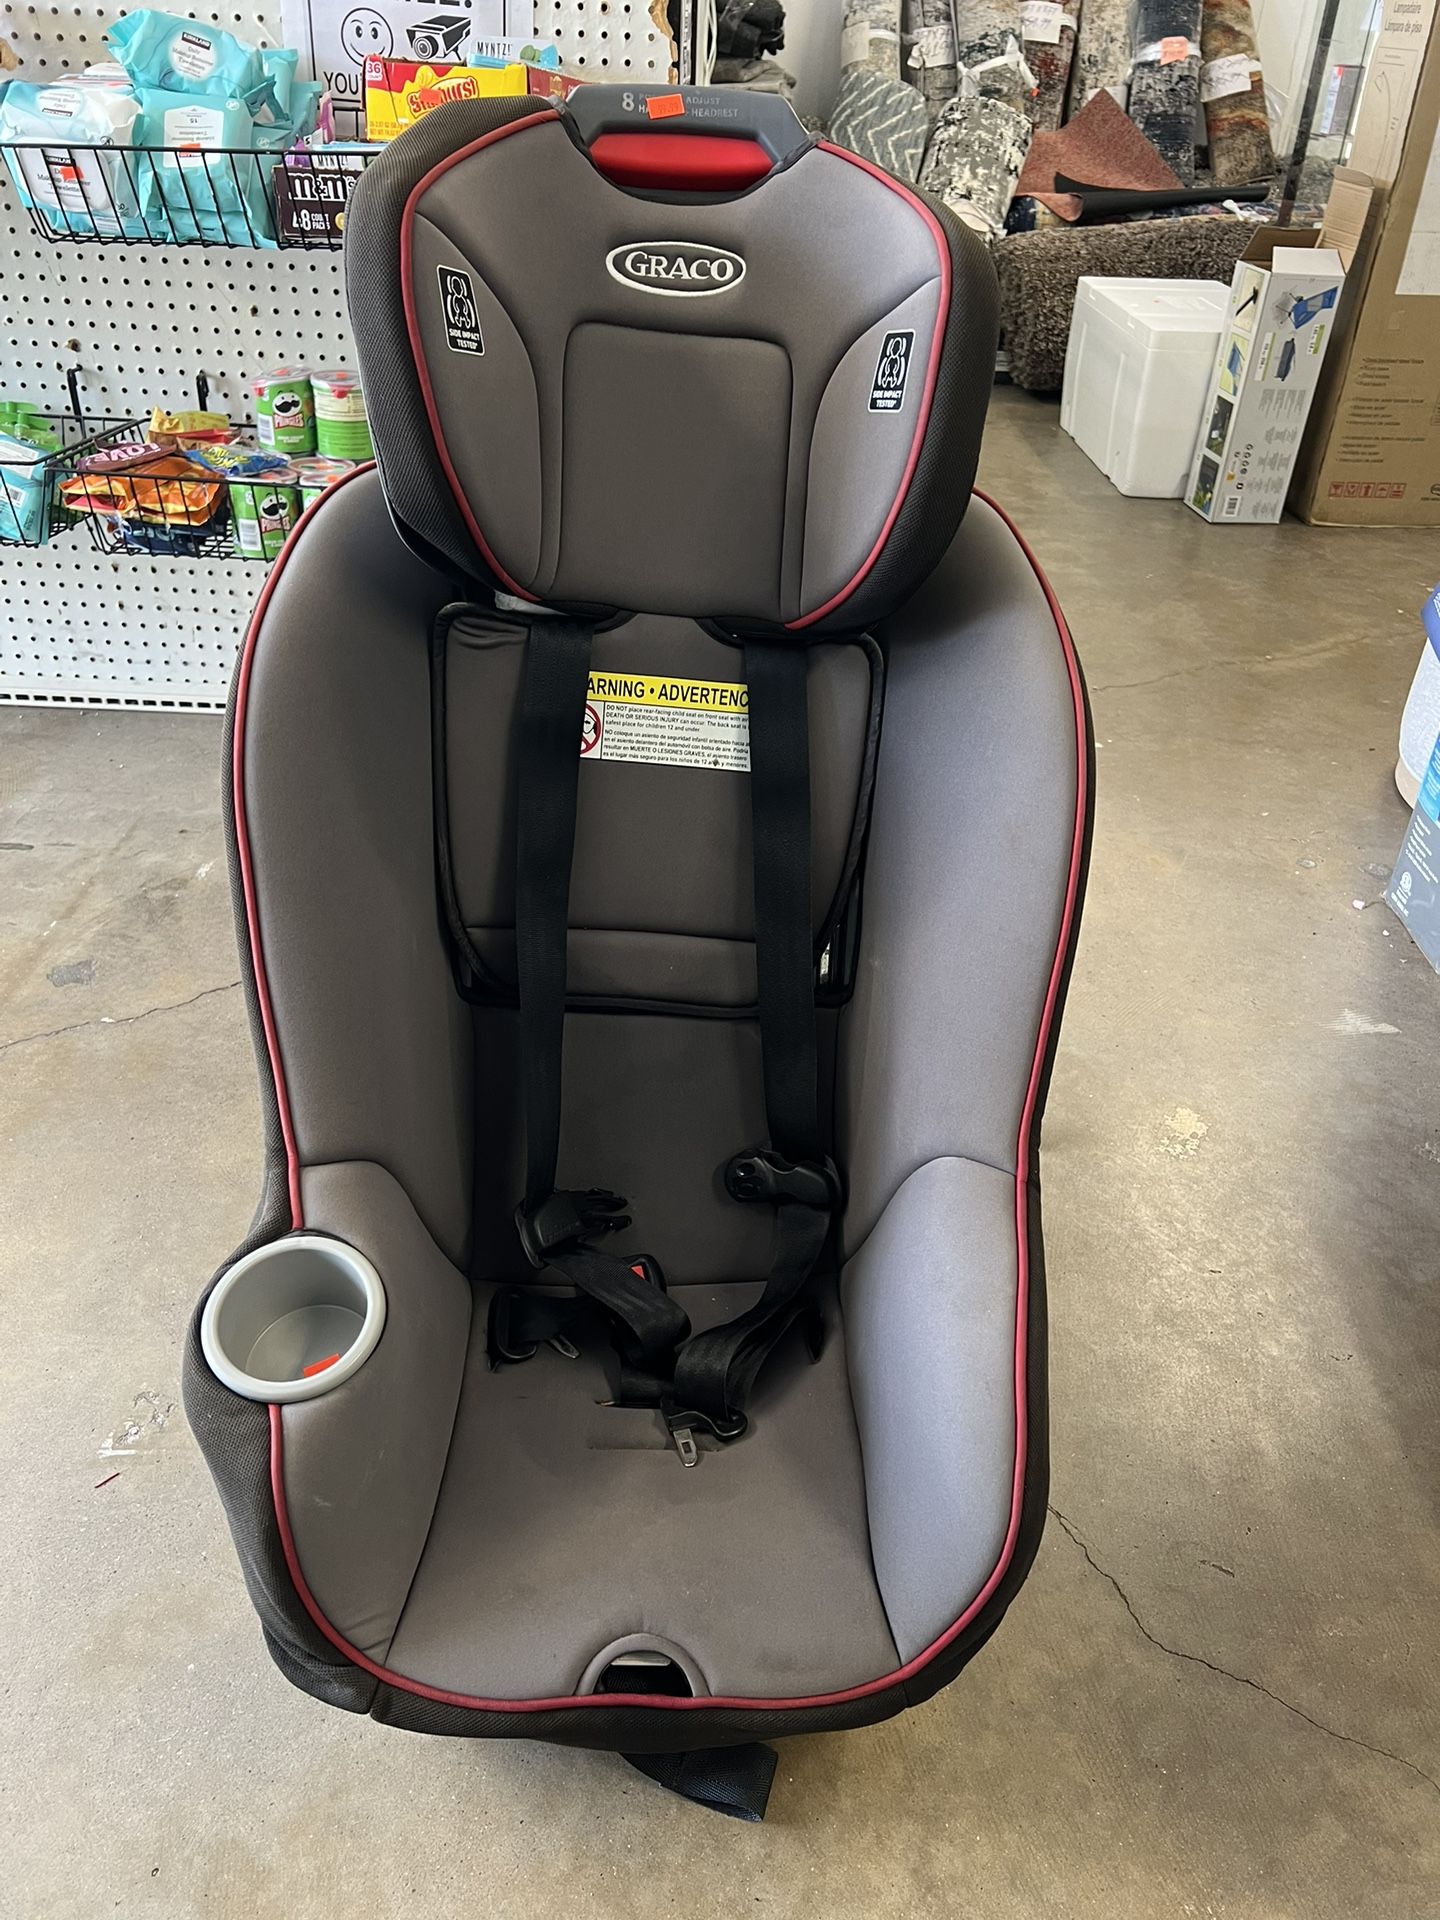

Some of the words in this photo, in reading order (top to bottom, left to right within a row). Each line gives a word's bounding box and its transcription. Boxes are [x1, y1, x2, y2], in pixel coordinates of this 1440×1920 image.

[367, 63, 380, 73] 36
[622, 92, 635, 111] 8
[687, 96, 721, 105] ADJUST
[691, 107, 739, 118] HEADREST
[625, 251, 734, 281] GRACO
[449, 328, 461, 338] SIDE
[461, 330, 480, 341] IMPACT
[873, 390, 884, 399] SIDE
[883, 390, 902, 399] IMPACT
[587, 677, 645, 698] ARNING
[658, 683, 749, 708] ADVERTENC
